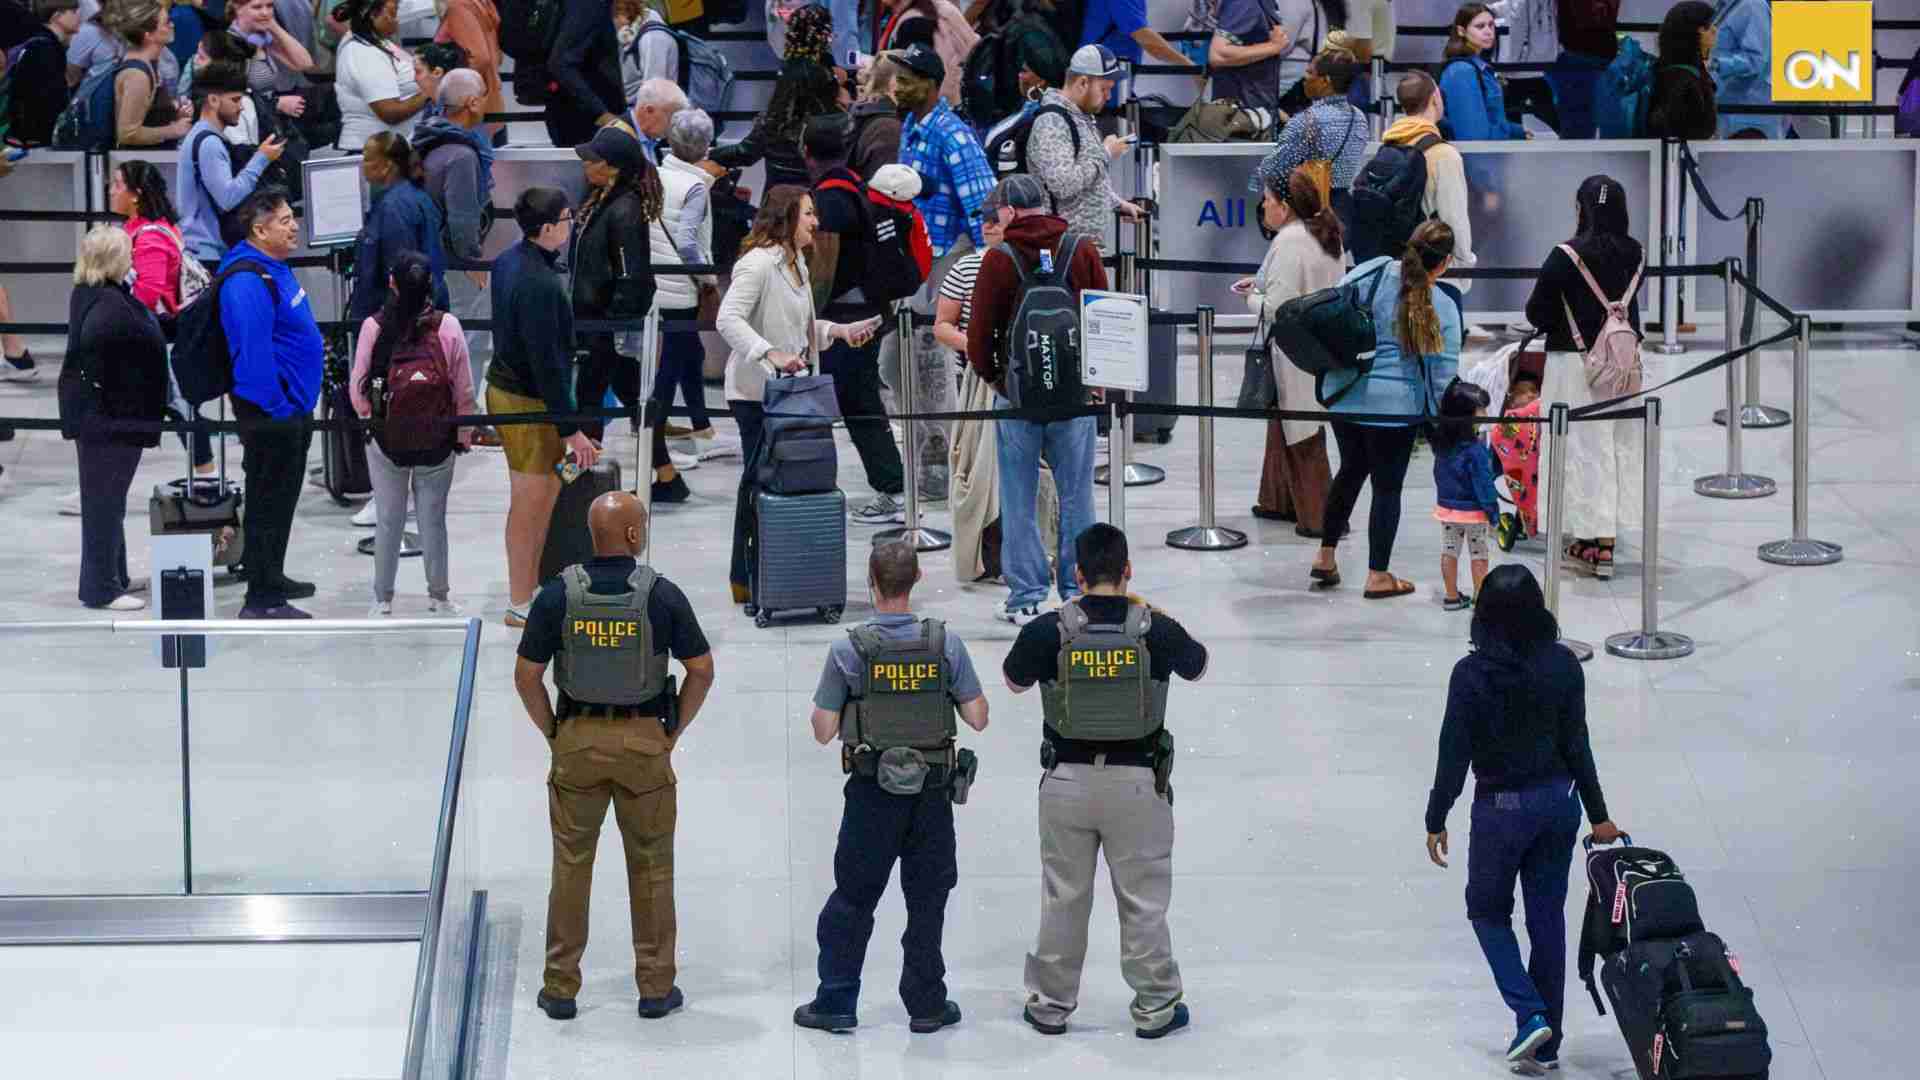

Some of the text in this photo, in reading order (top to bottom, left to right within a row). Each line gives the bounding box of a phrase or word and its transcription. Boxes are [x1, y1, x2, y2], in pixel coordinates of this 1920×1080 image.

[1197, 198, 1245, 227] All
[1040, 335, 1053, 390] MAXTOP
[574, 621, 637, 636] POLICE
[591, 636, 621, 648] ICE
[1071, 650, 1136, 666] POLICE
[874, 664, 938, 679] POLICE
[1089, 665, 1119, 678] ICE
[892, 679, 921, 691] ICE
